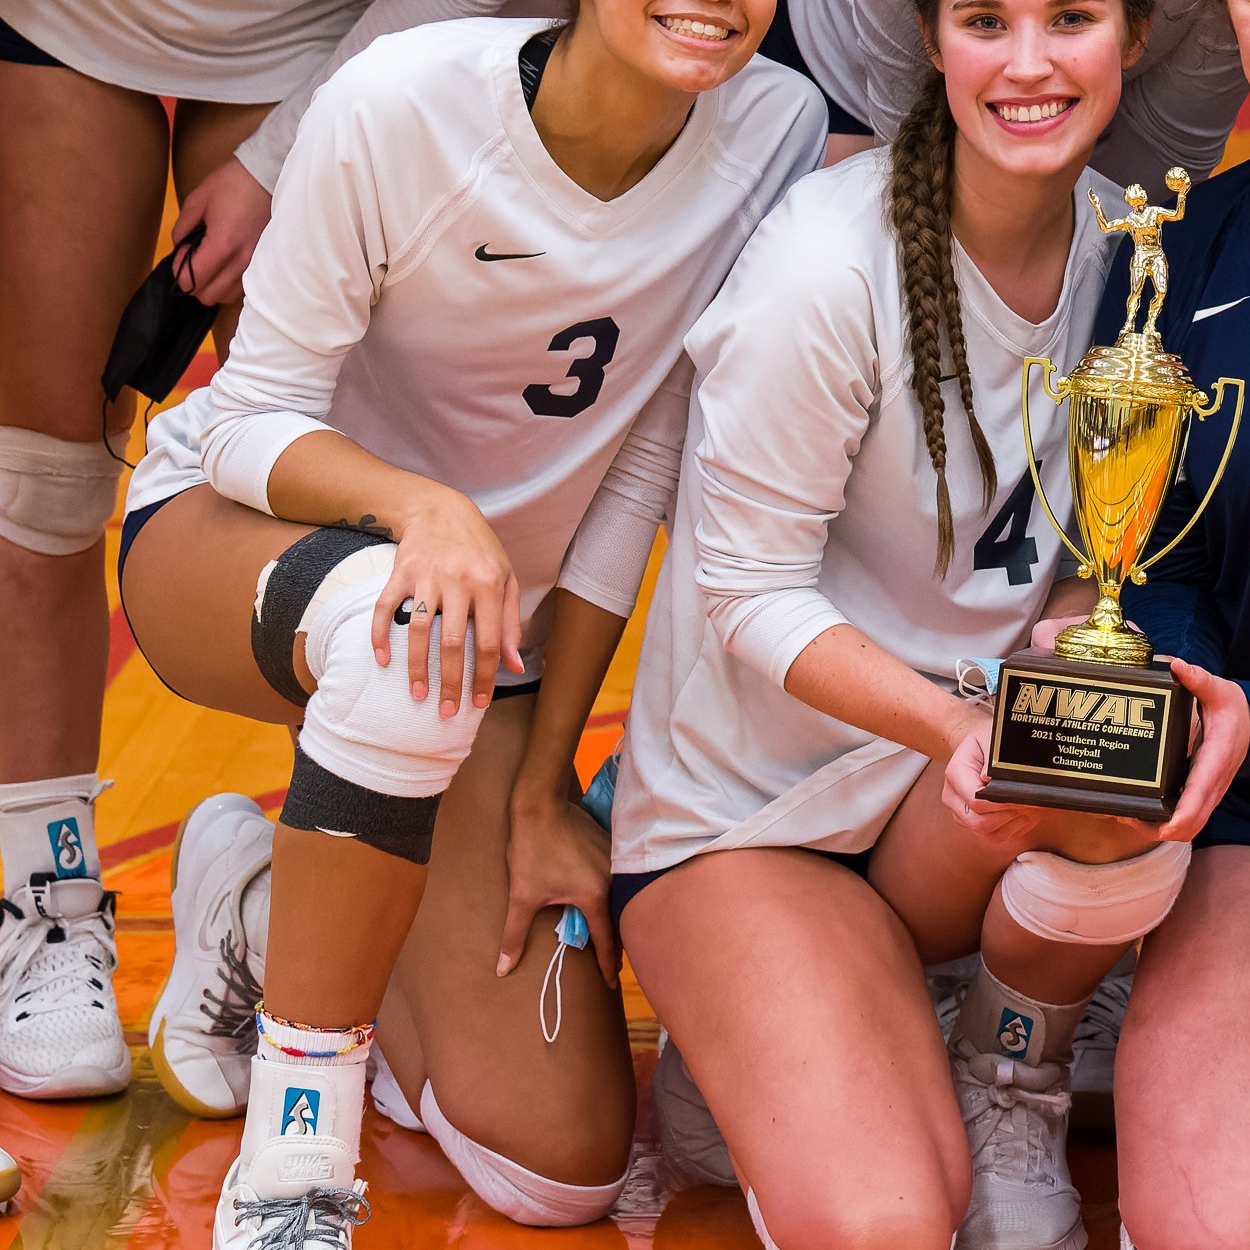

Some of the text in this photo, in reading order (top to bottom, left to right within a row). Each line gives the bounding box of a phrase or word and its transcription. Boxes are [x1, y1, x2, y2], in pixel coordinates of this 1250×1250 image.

[522, 316, 621, 418] 3
[973, 458, 1043, 586] 4
[1011, 681, 1156, 730] NWAC
[1010, 712, 1155, 739] NORTHWEST ATHLETIC CONFERENCE
[1031, 729, 1130, 751] 2021 Southern Region
[1057, 744, 1101, 758] Volleyball
[1052, 755, 1104, 770] Champions
